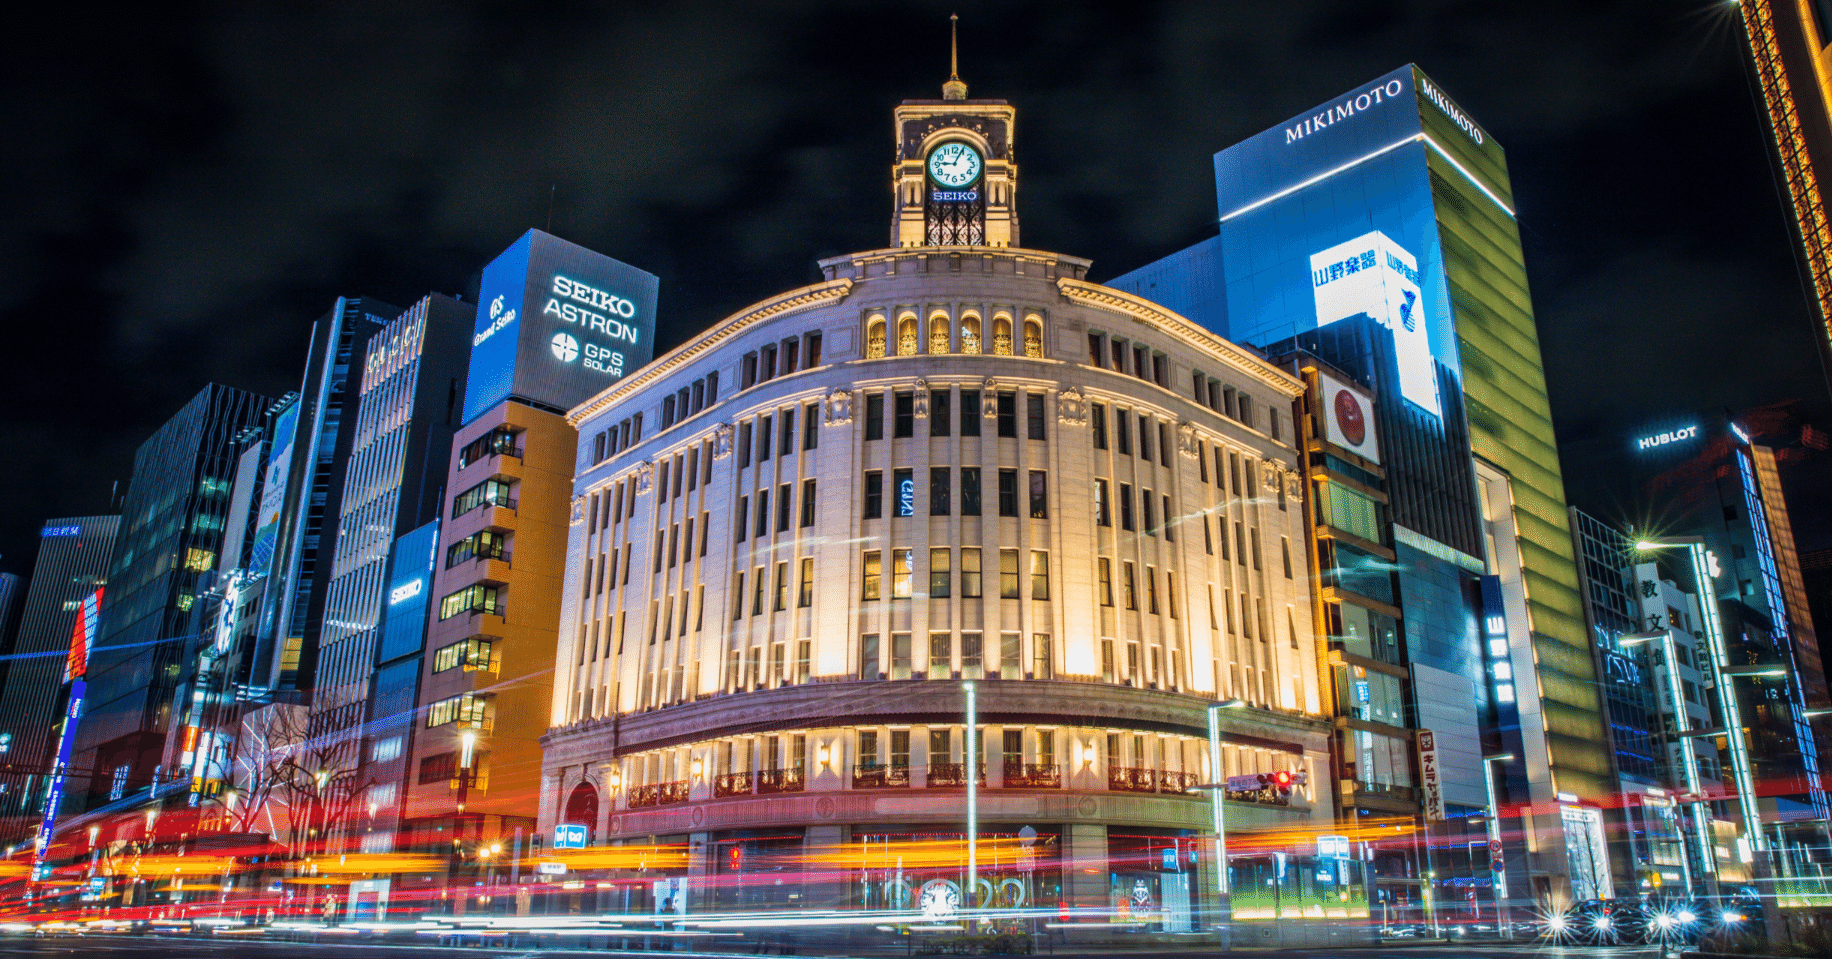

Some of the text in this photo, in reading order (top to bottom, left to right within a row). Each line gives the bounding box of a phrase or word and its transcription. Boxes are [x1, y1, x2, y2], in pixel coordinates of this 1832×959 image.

[1284, 78, 1403, 145] MIKIMOTO
[1421, 78, 1484, 145] MIKIMOTO
[932, 191, 978, 201] SEIKO
[1313, 249, 1377, 288] 山野楽器
[489, 294, 505, 320] GS
[552, 275, 636, 319] SEIKO
[473, 308, 517, 347] Grand Seiko
[543, 298, 638, 344] ASTRON
[583, 358, 623, 378] SOLAR
[584, 343, 625, 367] GPS
[1638, 425, 1698, 450] HUBLOT
[390, 578, 422, 605] SEIKO
